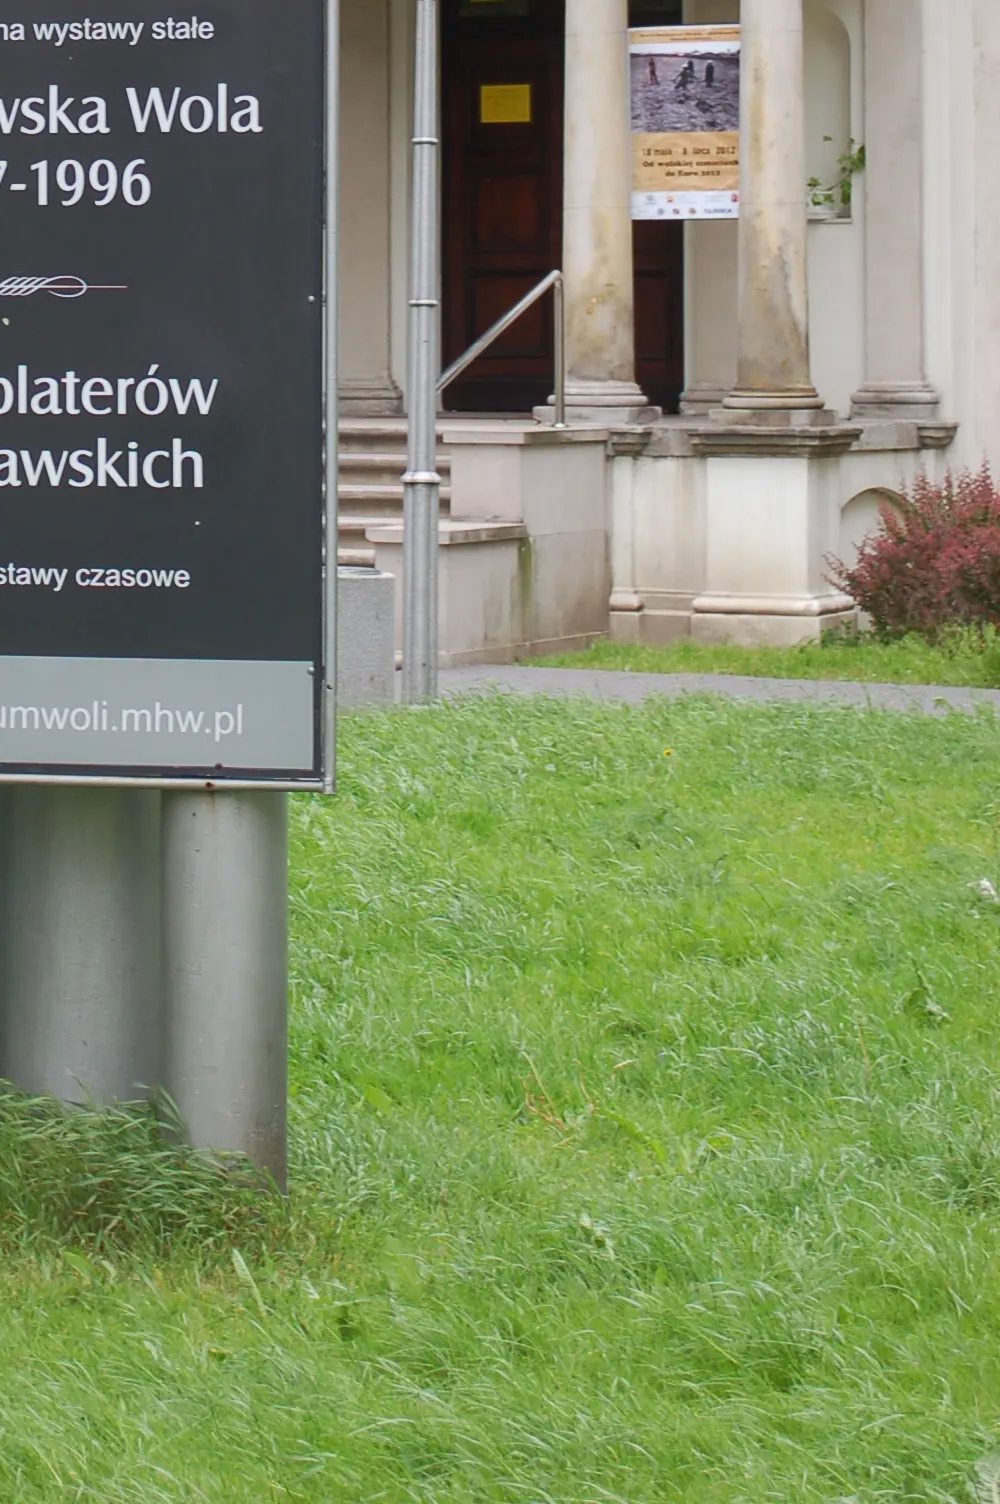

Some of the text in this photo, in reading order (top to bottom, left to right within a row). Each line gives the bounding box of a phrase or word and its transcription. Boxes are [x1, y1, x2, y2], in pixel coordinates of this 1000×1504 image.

[32, 17, 145, 47] wystawy
[151, 15, 215, 40] stałe
[125, 82, 264, 133] Wola
[75, 568, 191, 588] czasowe
